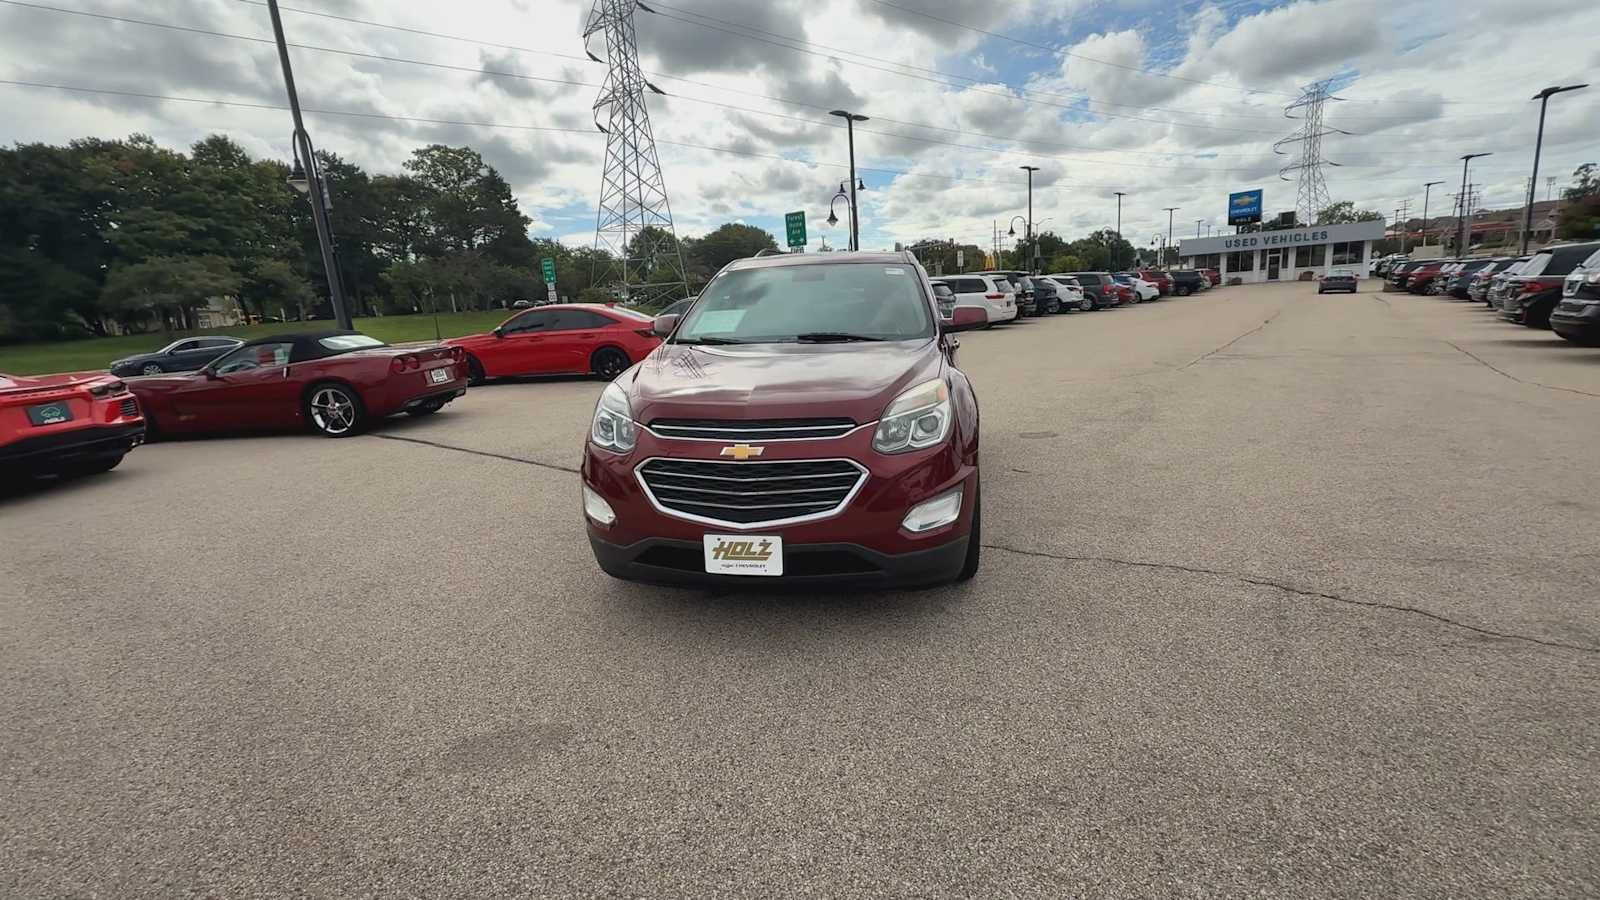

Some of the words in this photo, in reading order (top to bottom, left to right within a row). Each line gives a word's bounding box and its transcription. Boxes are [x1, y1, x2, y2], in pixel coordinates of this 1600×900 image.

[1225, 237, 1257, 248] USED
[1263, 230, 1328, 245] VEHICLES
[712, 541, 773, 561] HOLZ
